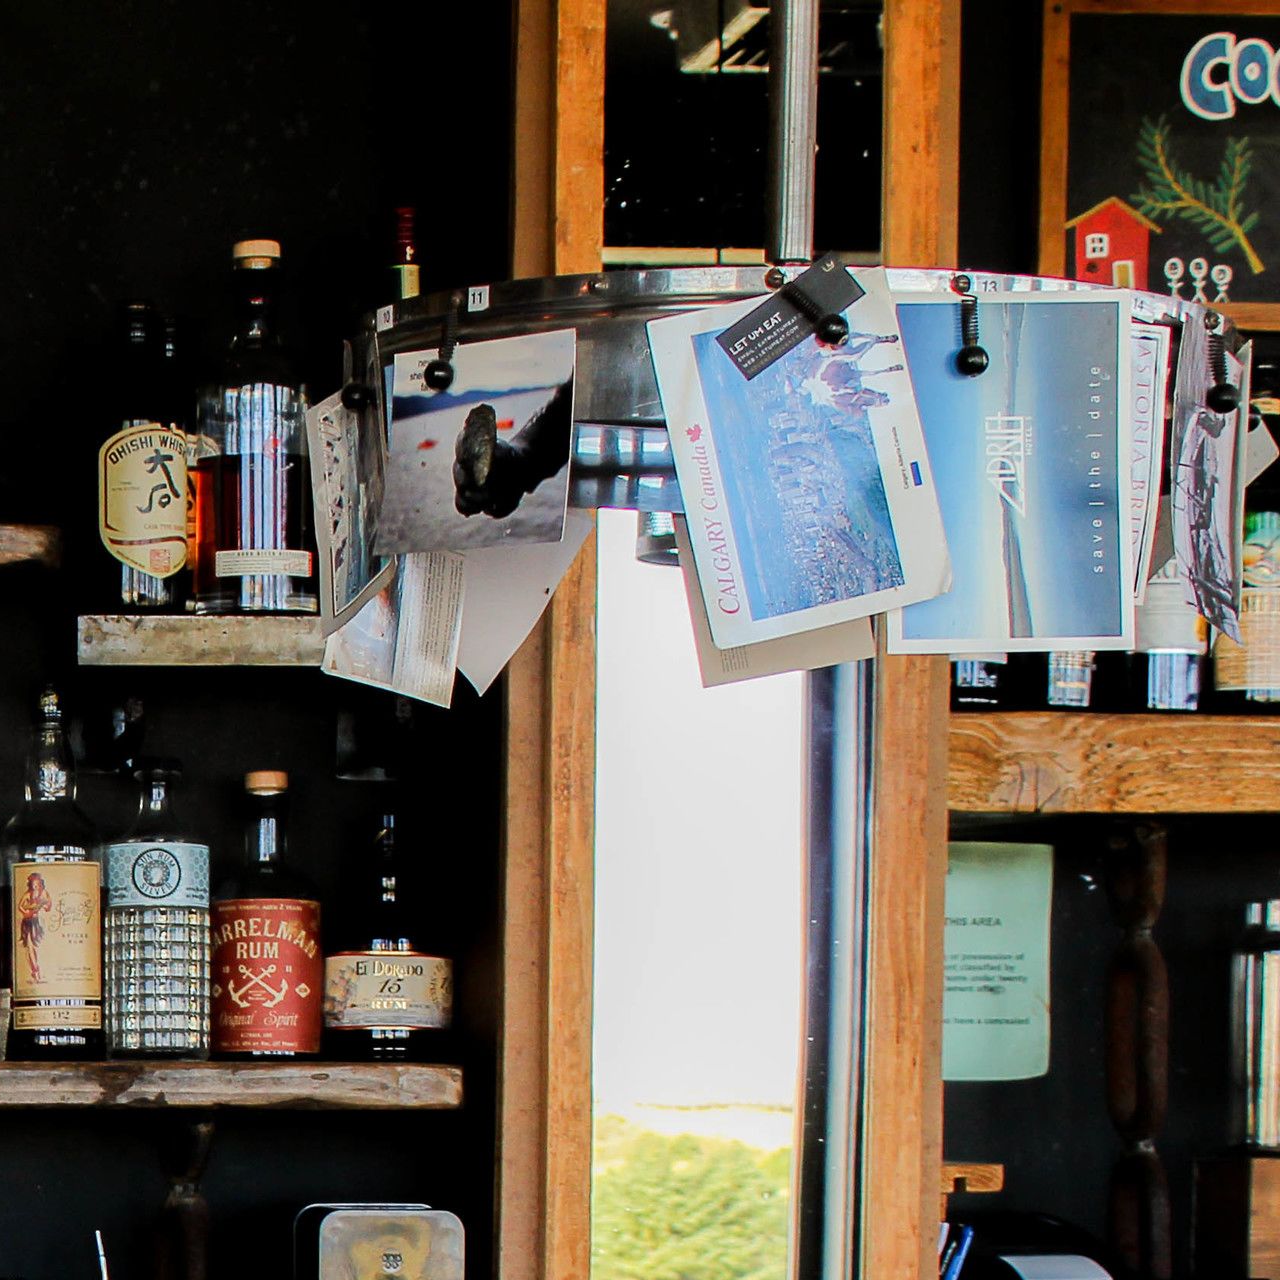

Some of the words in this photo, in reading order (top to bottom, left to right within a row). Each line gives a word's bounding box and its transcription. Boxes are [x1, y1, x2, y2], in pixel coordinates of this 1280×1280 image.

[471, 292, 482, 305] 11
[729, 337, 748, 355] LET
[748, 327, 765, 341] UM
[763, 312, 782, 330] EAT
[1088, 365, 1102, 420] date
[1134, 344, 1153, 463] ASTORIA
[109, 436, 153, 465] OHISHI
[691, 445, 719, 511] Canada
[1088, 448, 1101, 490] the
[1089, 519, 1103, 573] save
[704, 520, 740, 615] CALGARY
[137, 849, 154, 868] SUN
[157, 850, 177, 868] RUM
[140, 882, 174, 896] SILVER
[212, 917, 318, 959] ARRELMAN
[971, 917, 1002, 926] AREA
[236, 941, 279, 959] RUM
[378, 979, 402, 993] 15
[370, 1000, 407, 1010] RUM
